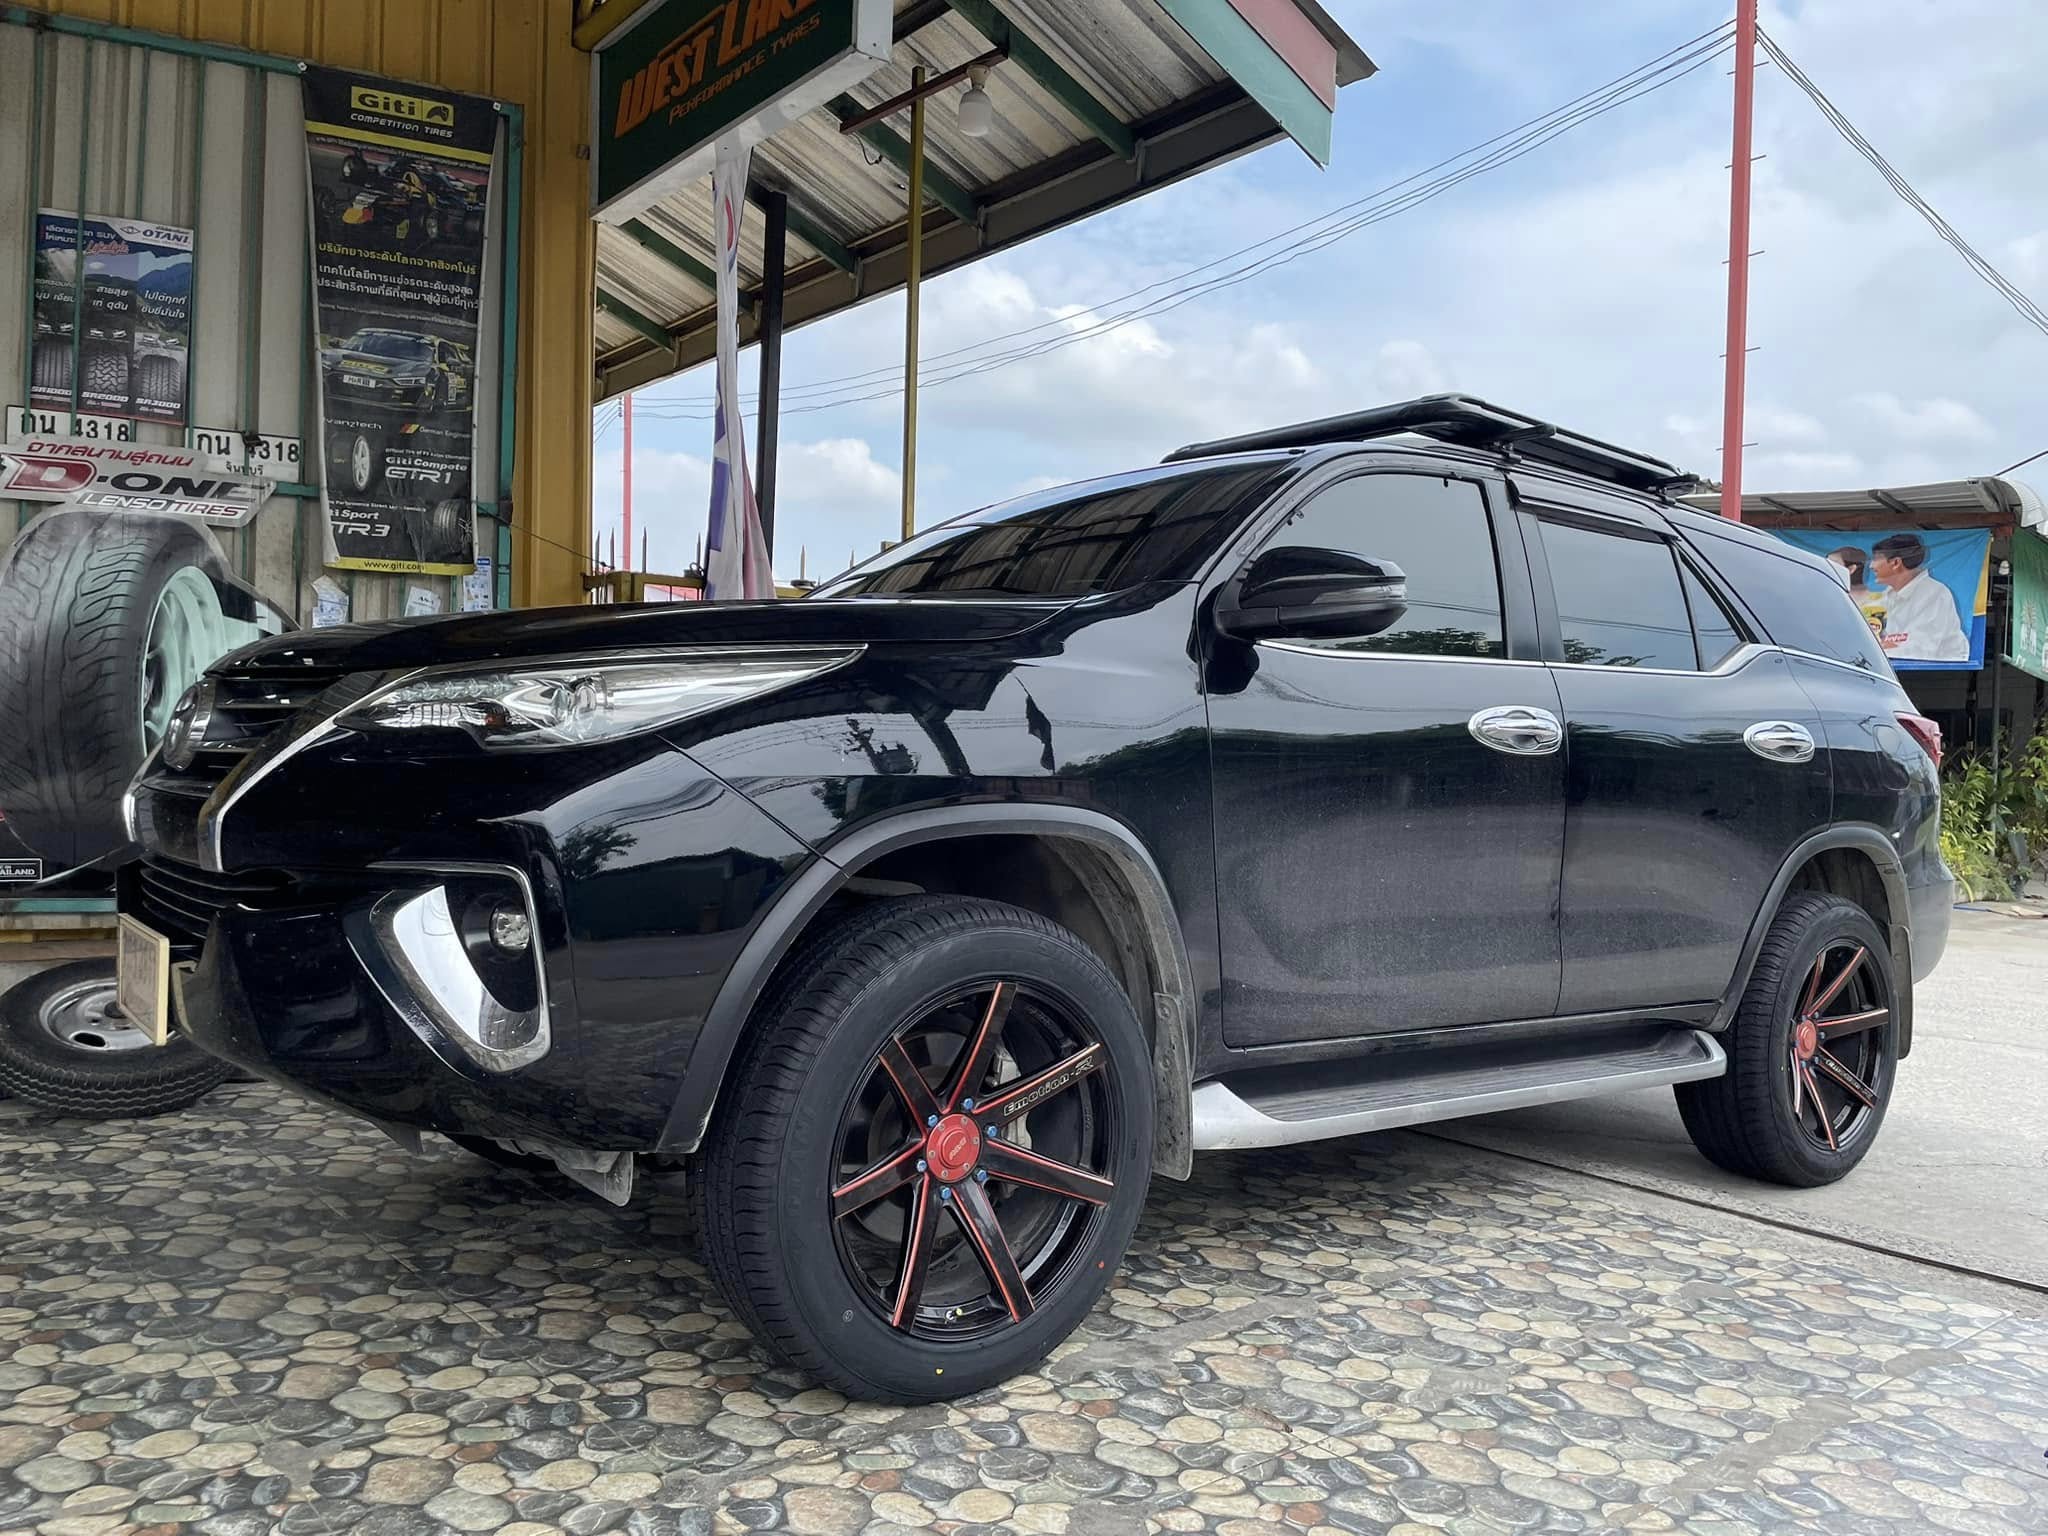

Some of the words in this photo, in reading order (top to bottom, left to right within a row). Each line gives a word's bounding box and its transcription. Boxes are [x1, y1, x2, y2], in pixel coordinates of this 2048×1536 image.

[668, 49, 767, 126] PERFORMANCE
[770, 12, 820, 55] TYRES
[614, 26, 715, 138] WEST
[357, 92, 417, 116] Giti
[350, 112, 419, 132] COMPETITION
[424, 125, 454, 138] TIRES
[142, 229, 189, 244] OTANI
[27, 441, 194, 467] จากสนามสู่ถนน
[197, 433, 231, 455] กน
[413, 458, 468, 471] Compete
[83, 492, 166, 511] LENSO
[171, 501, 243, 517] TIRES
[340, 509, 380, 521] Sport
[331, 520, 391, 538] TR3
